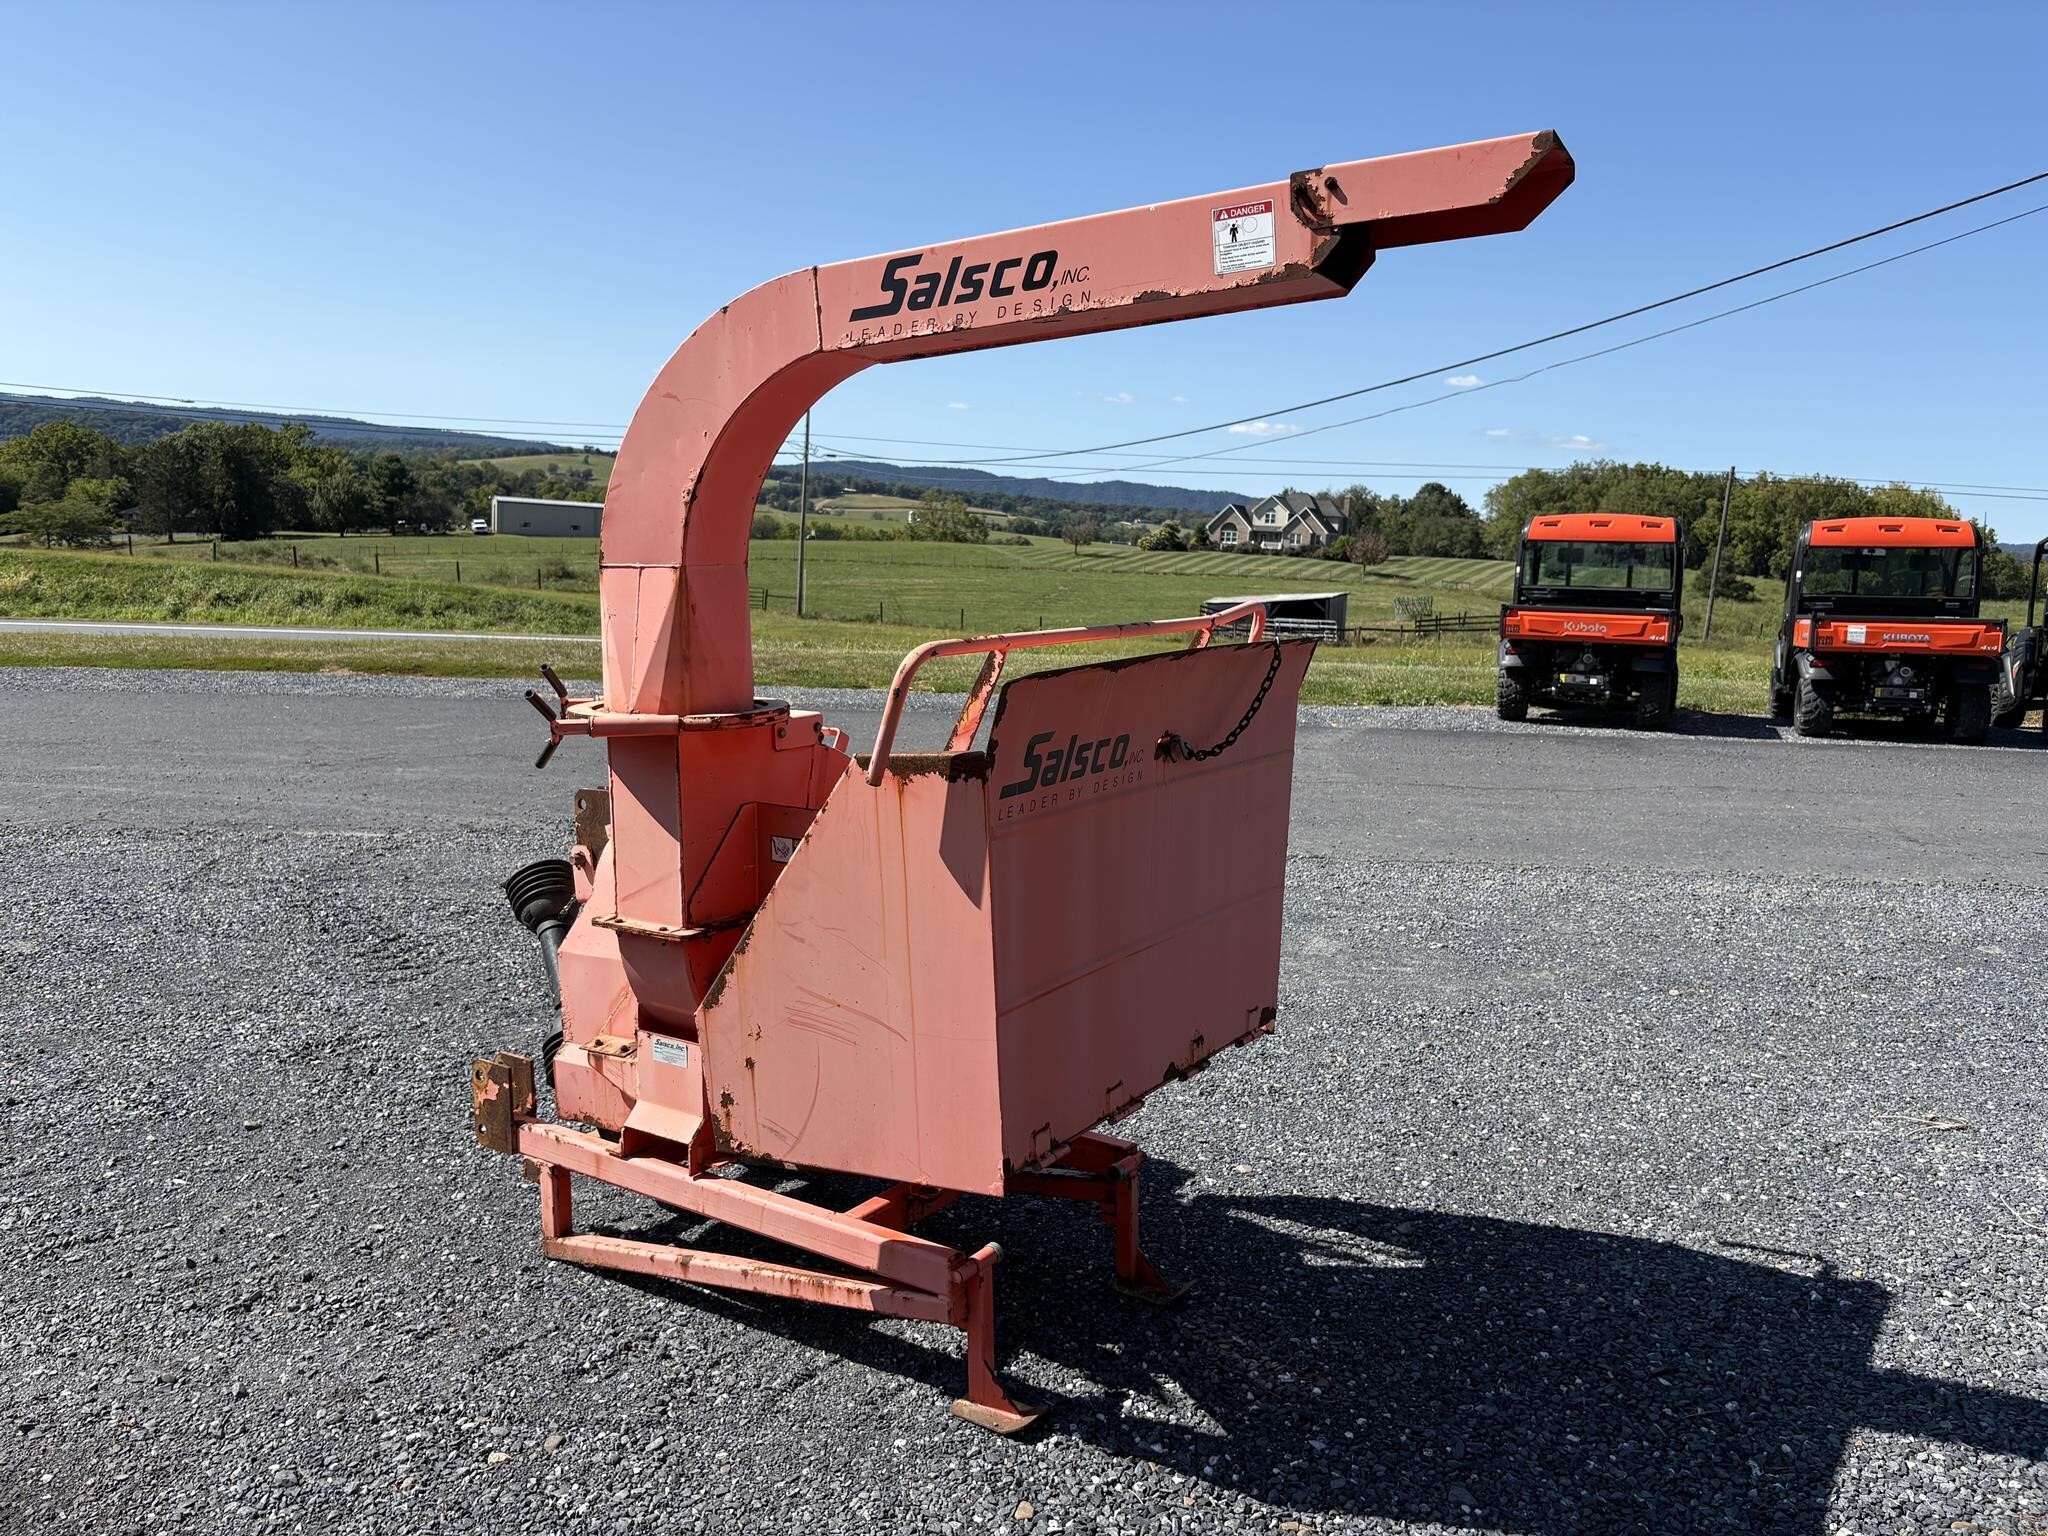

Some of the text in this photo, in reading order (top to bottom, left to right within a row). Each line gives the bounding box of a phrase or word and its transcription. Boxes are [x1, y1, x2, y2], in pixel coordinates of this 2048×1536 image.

[1230, 204, 1266, 218] DANGER
[849, 250, 1090, 322] Salsco, INC.
[848, 291, 1092, 342] LEADER BY DESIGN
[1563, 621, 1607, 633] Kubota
[1882, 633, 1931, 642] KUBOTA
[999, 731, 1144, 800] Salsco, INC.
[998, 770, 1144, 821] LEADER BY DESIGN
